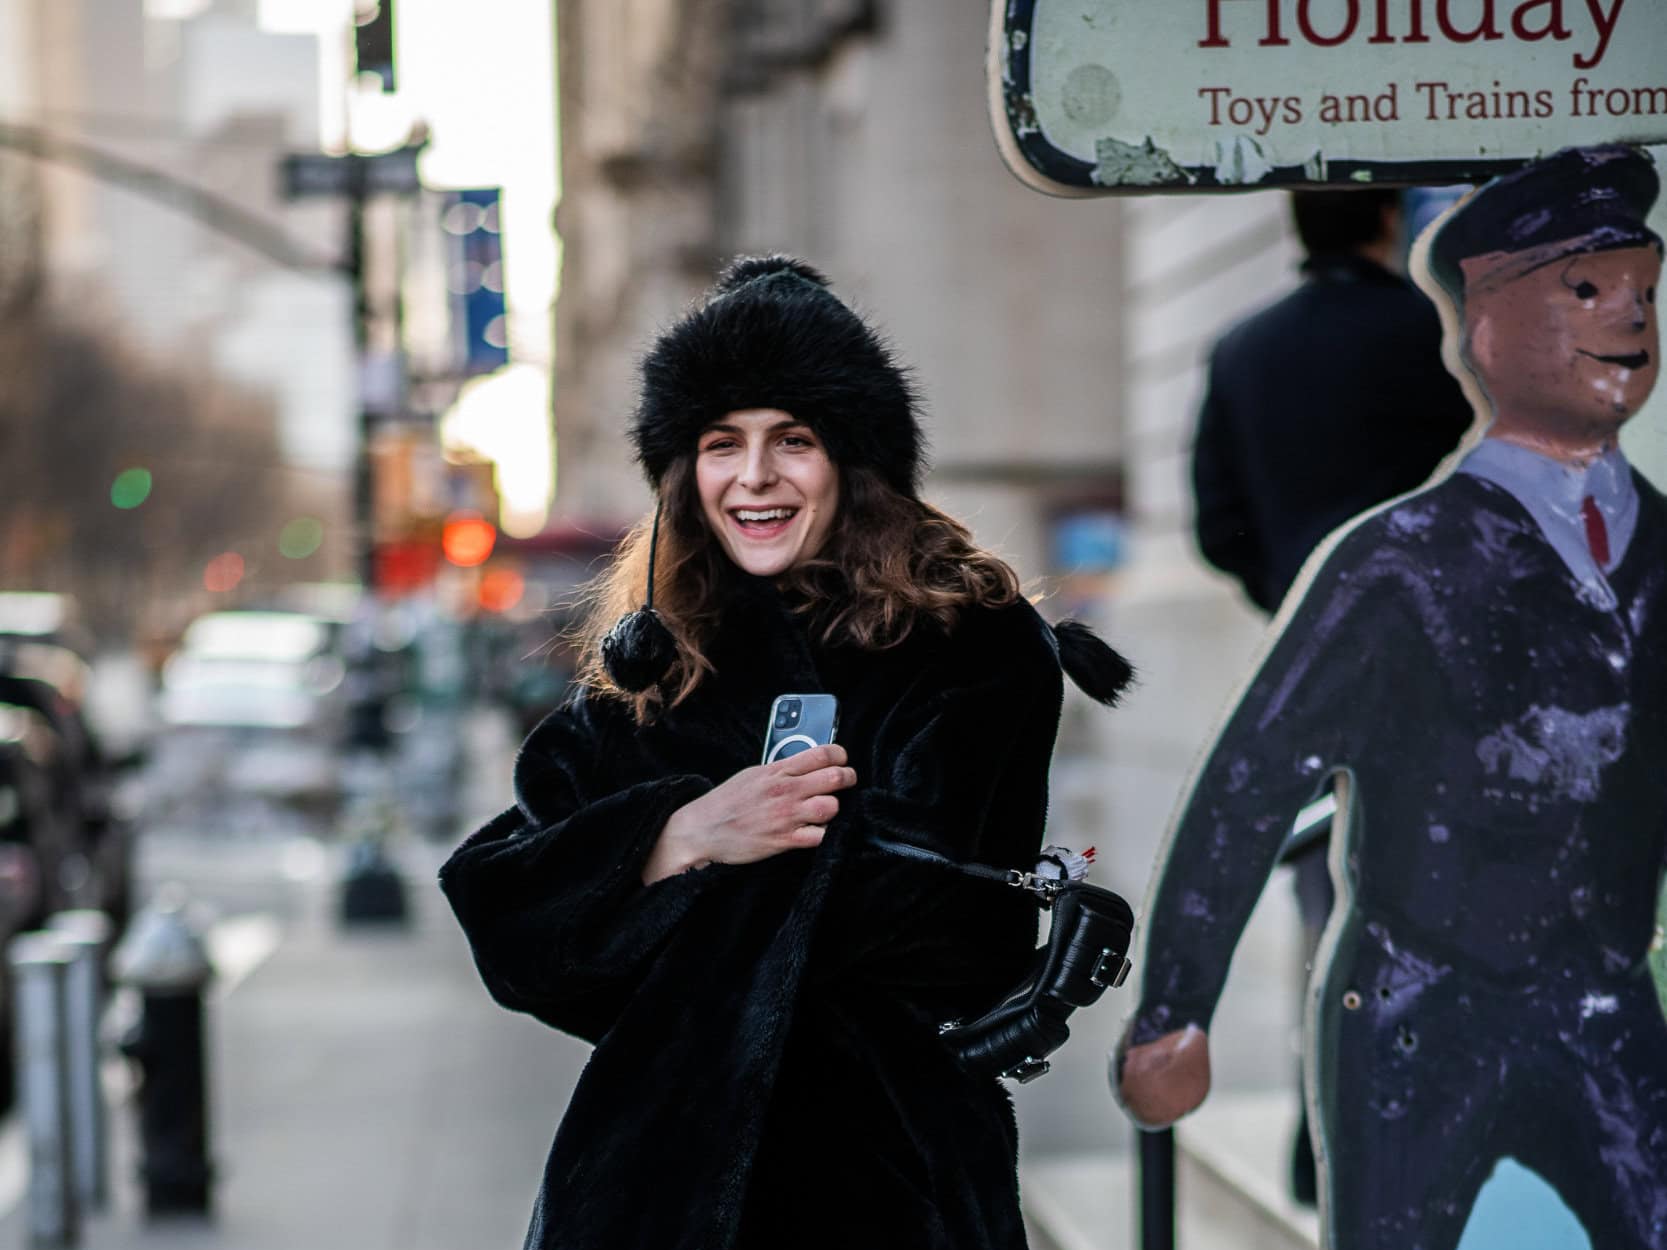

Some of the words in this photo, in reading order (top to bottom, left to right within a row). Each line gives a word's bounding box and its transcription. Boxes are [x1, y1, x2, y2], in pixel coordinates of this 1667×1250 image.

[1198, 87, 1302, 136] Toys
[1319, 82, 1399, 124] and
[1416, 80, 1554, 120] Trains
[1569, 77, 1667, 117] from
